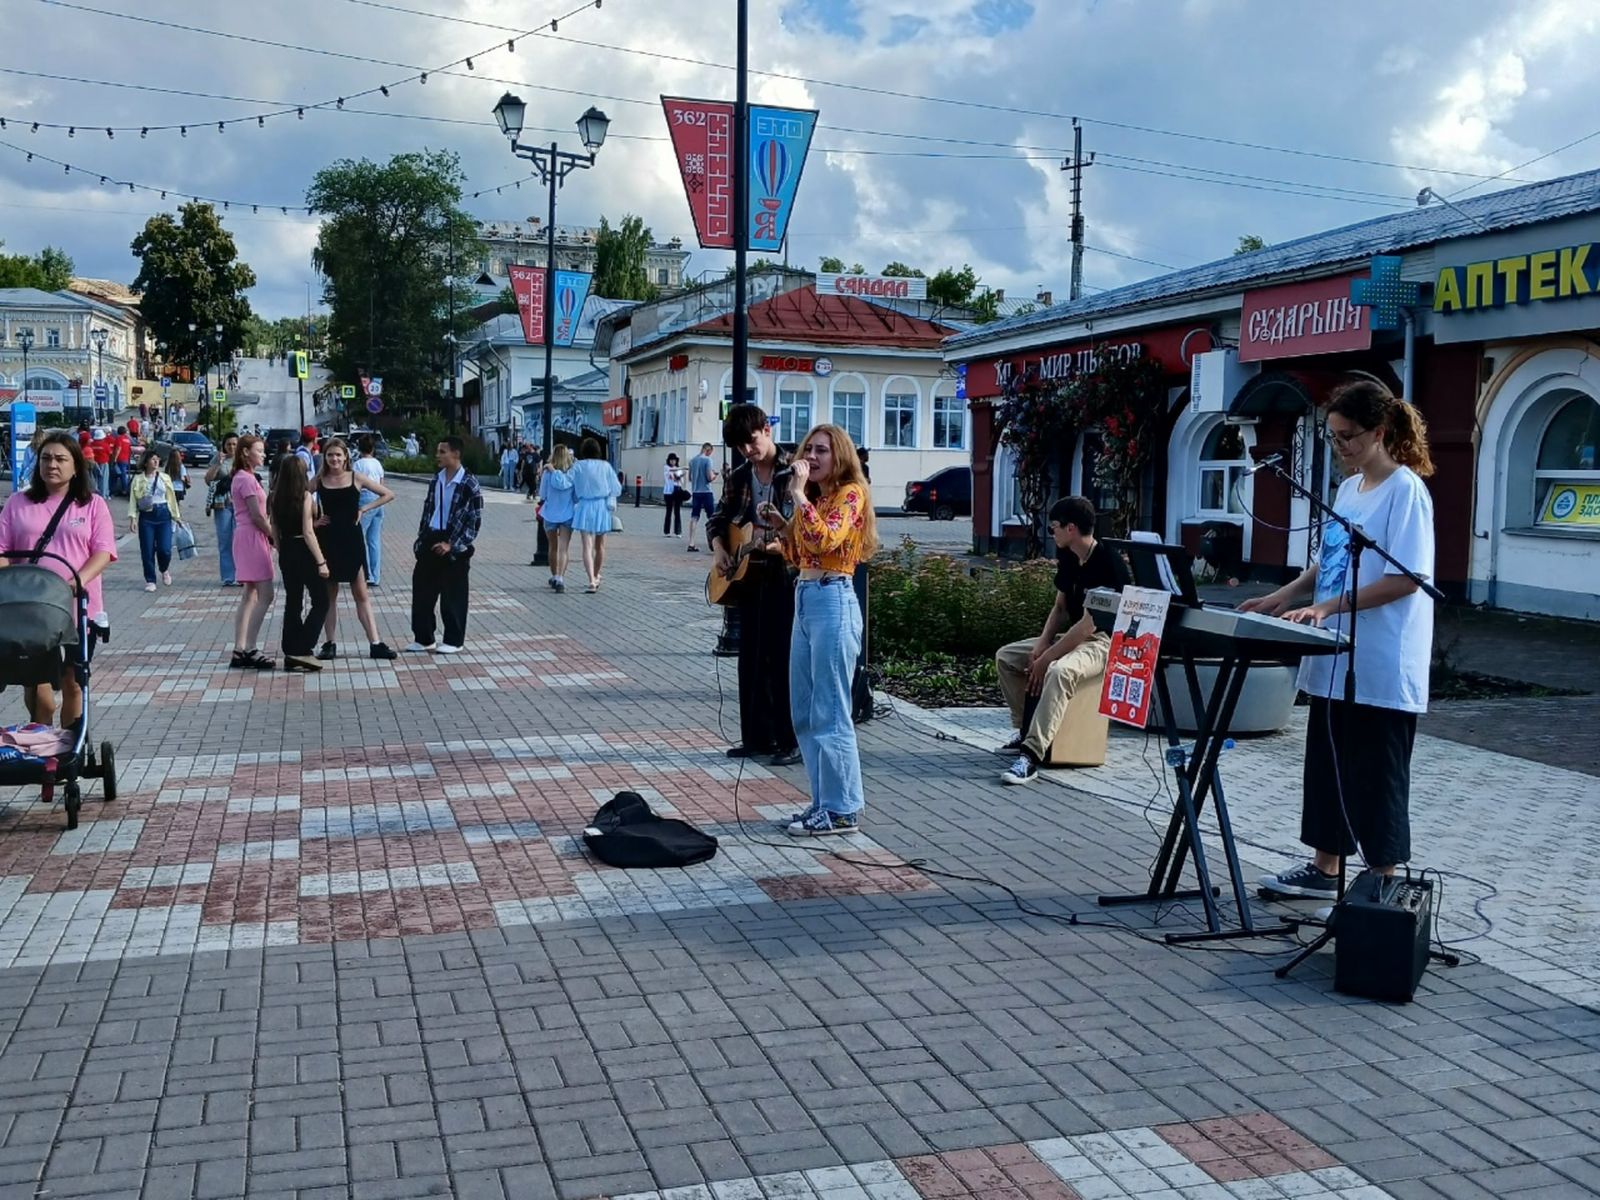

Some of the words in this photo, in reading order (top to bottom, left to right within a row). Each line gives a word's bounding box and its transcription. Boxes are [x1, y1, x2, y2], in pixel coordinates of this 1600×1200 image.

[673, 109, 706, 126] 362
[757, 117, 803, 138] ЭТО
[754, 211, 777, 240] Я
[1433, 243, 1600, 312] АПТЕК
[1039, 353, 1071, 380] МИР
[0, 750, 17, 760] НК
